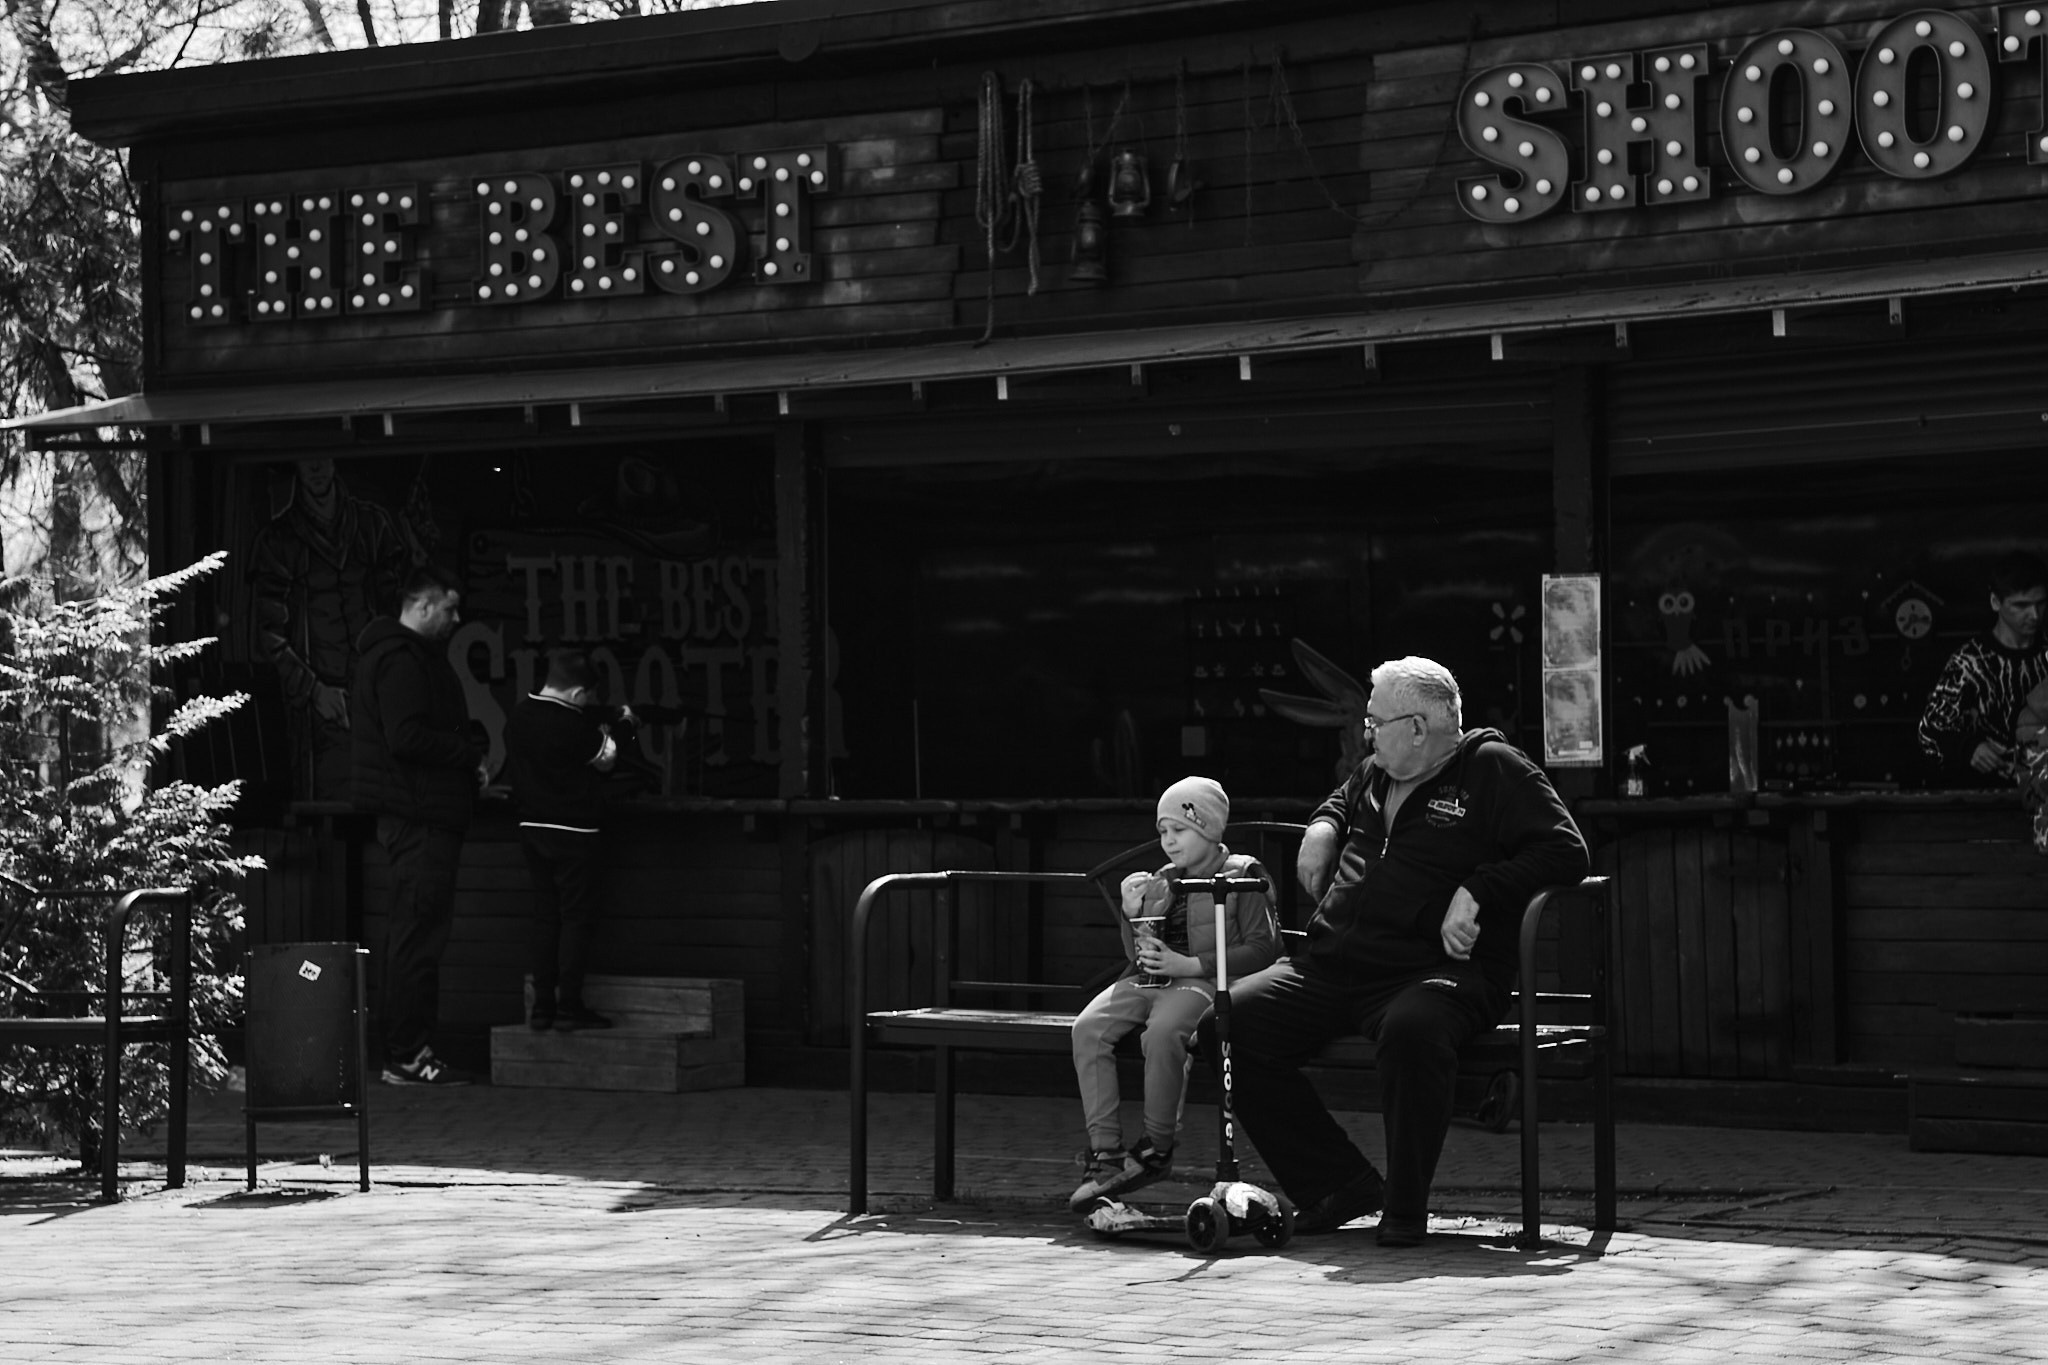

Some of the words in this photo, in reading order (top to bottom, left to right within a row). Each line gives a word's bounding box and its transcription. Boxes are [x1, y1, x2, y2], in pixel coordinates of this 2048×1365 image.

[167, 183, 424, 327] THE
[471, 145, 831, 304] BEST
[506, 551, 642, 643] THE
[659, 553, 780, 642] BEST
[447, 620, 850, 785] SOTE
[419, 1064, 440, 1081] N
